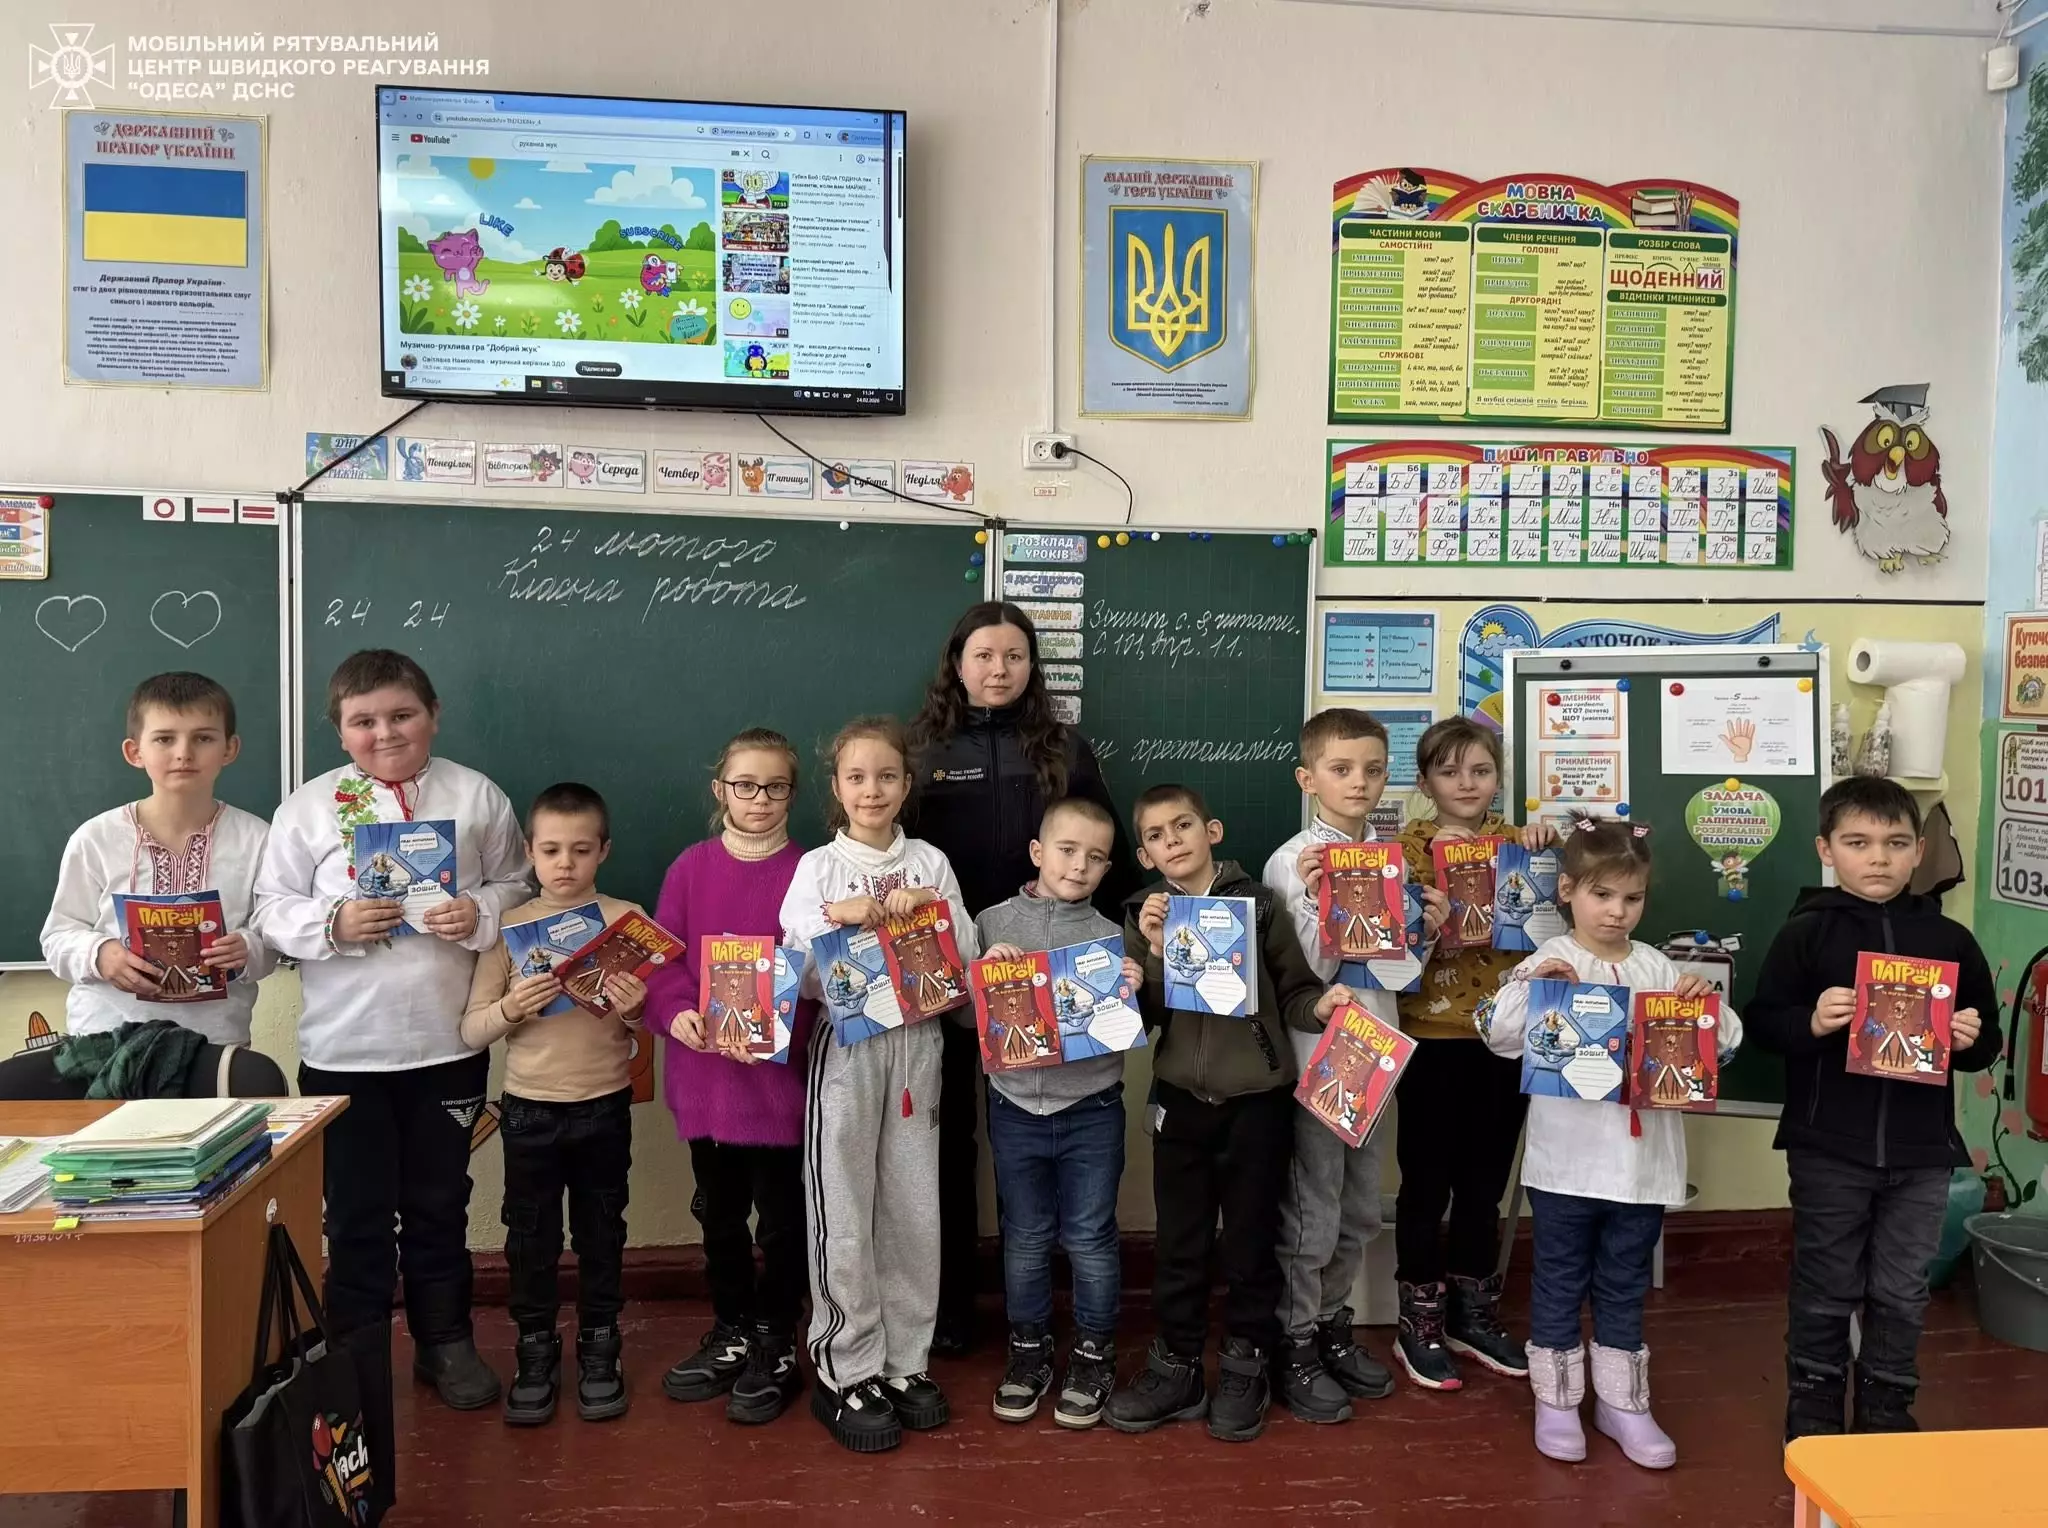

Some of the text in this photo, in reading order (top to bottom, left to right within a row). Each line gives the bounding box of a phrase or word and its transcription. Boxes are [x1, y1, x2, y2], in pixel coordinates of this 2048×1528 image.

[424, 135, 451, 145] YouTube
[1123, 186, 1157, 198] ГЕРБ
[1506, 183, 1576, 200] МОВНА
[1477, 201, 1604, 221] СКАРБНИЧКА
[479, 212, 515, 238] LIKE
[619, 226, 683, 252] SUBSCRIBE
[1369, 229, 1442, 239] ЧАСТИНИ МОВИ
[1503, 232, 1577, 244] ЧЛЕНИ РЕЧЕННЯ
[1379, 240, 1433, 250] САМОСТІЙНІ
[1522, 246, 1559, 254] ГОЛОВНІ
[1637, 239, 1701, 250] РОЗБІР СЛОВА
[99, 274, 221, 286] Державний Прапор України
[1610, 269, 1723, 289] ЩОДЕННИЙ
[1509, 296, 1562, 305] ДРУГОРЯДНІ
[1619, 292, 1716, 304] ВІДМІНКИ ІМЕННИКІВ
[400, 341, 470, 351] Музично-рухлива
[472, 343, 485, 353] гра
[1379, 351, 1424, 360] СЛУЖБОВІ
[1482, 448, 1649, 464] ПИШИ ПРАВИЛЬНО
[427, 458, 472, 470] Понеділок
[487, 461, 530, 472] Вівторок
[602, 462, 640, 476] Середа
[1366, 464, 1378, 472] Аа
[1407, 464, 1420, 472] Бб
[658, 466, 700, 481] Четвер
[1569, 467, 1581, 476] Дд
[854, 475, 888, 487] Субота
[905, 472, 941, 486] Неділя
[1447, 499, 1459, 507] Йй
[1529, 500, 1541, 508] Лл
[1687, 502, 1698, 510] Пп
[1725, 503, 1737, 511] Рр
[1407, 531, 1417, 541] Уу
[1443, 532, 1459, 541] Фф
[1528, 533, 1540, 541] Цц
[1604, 533, 1620, 541] Шш
[1643, 534, 1659, 542] Щщ
[594, 528, 776, 563] лютого
[1017, 537, 1074, 549] РОЗКЛАД
[1025, 549, 1070, 560] УРОКІВ
[1014, 574, 1082, 586] ДОСЛІДЖУЮ
[642, 561, 806, 623] робота
[1032, 583, 1057, 595] СВІТ
[1024, 609, 1072, 620] ИТАННЯ
[2015, 651, 2048, 669] безпе
[2005, 776, 2047, 803] 101
[1703, 791, 1765, 802] ЗАДАЧА
[1713, 807, 1752, 815] УМОВА
[1698, 816, 1767, 825] ЗАПИТАННЯ
[1702, 836, 1764, 845] ВІДПОВІДЬ
[1329, 847, 1389, 868] ПАТРОН
[1444, 840, 1494, 864] ПАТРОН
[2001, 866, 2043, 897] 103
[138, 907, 205, 927] ПАТРОН
[622, 917, 674, 954] ПАТРОН
[711, 941, 762, 961] ПАТРОН
[981, 957, 1037, 984] ПАТРОН
[1871, 959, 1942, 987] ПАТРОН
[1645, 997, 1705, 1018] ПАТРОН
[1343, 1007, 1399, 1057] ПАТРОН
